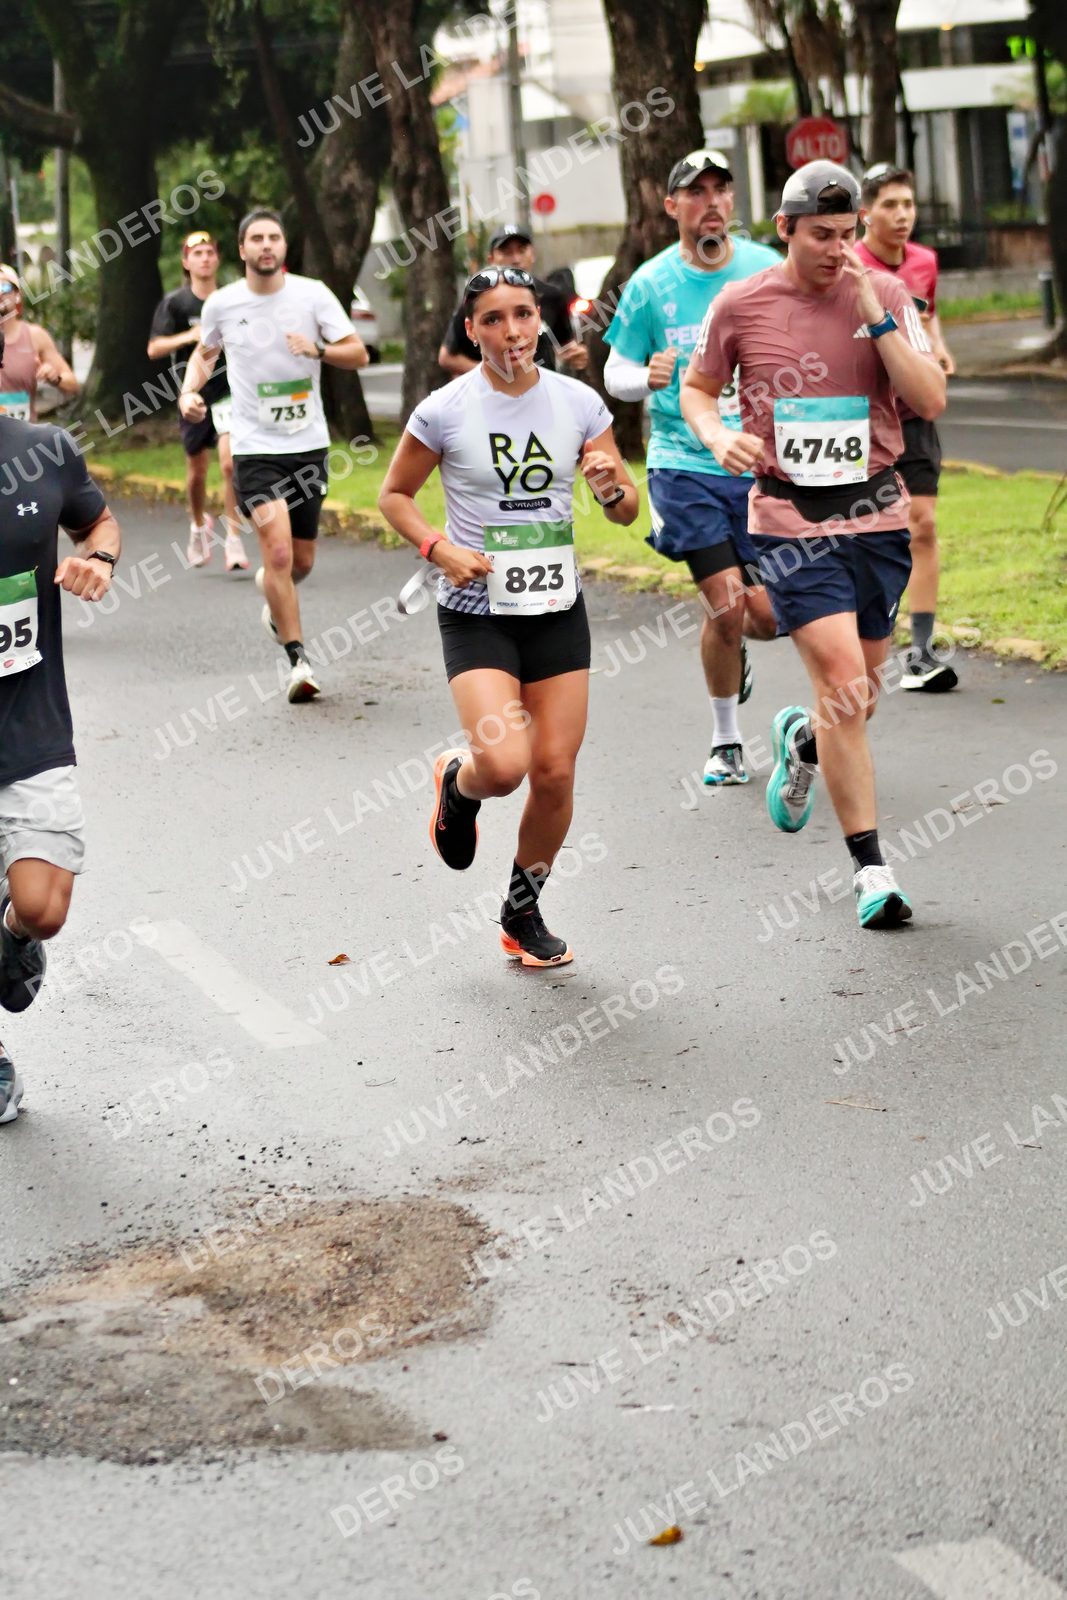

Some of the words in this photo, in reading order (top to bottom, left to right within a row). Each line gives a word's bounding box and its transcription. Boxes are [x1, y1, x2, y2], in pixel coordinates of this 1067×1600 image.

[793, 134, 842, 158] ALTO
[270, 404, 307, 423] 733
[782, 436, 863, 464] 4748
[505, 563, 564, 593] 823
